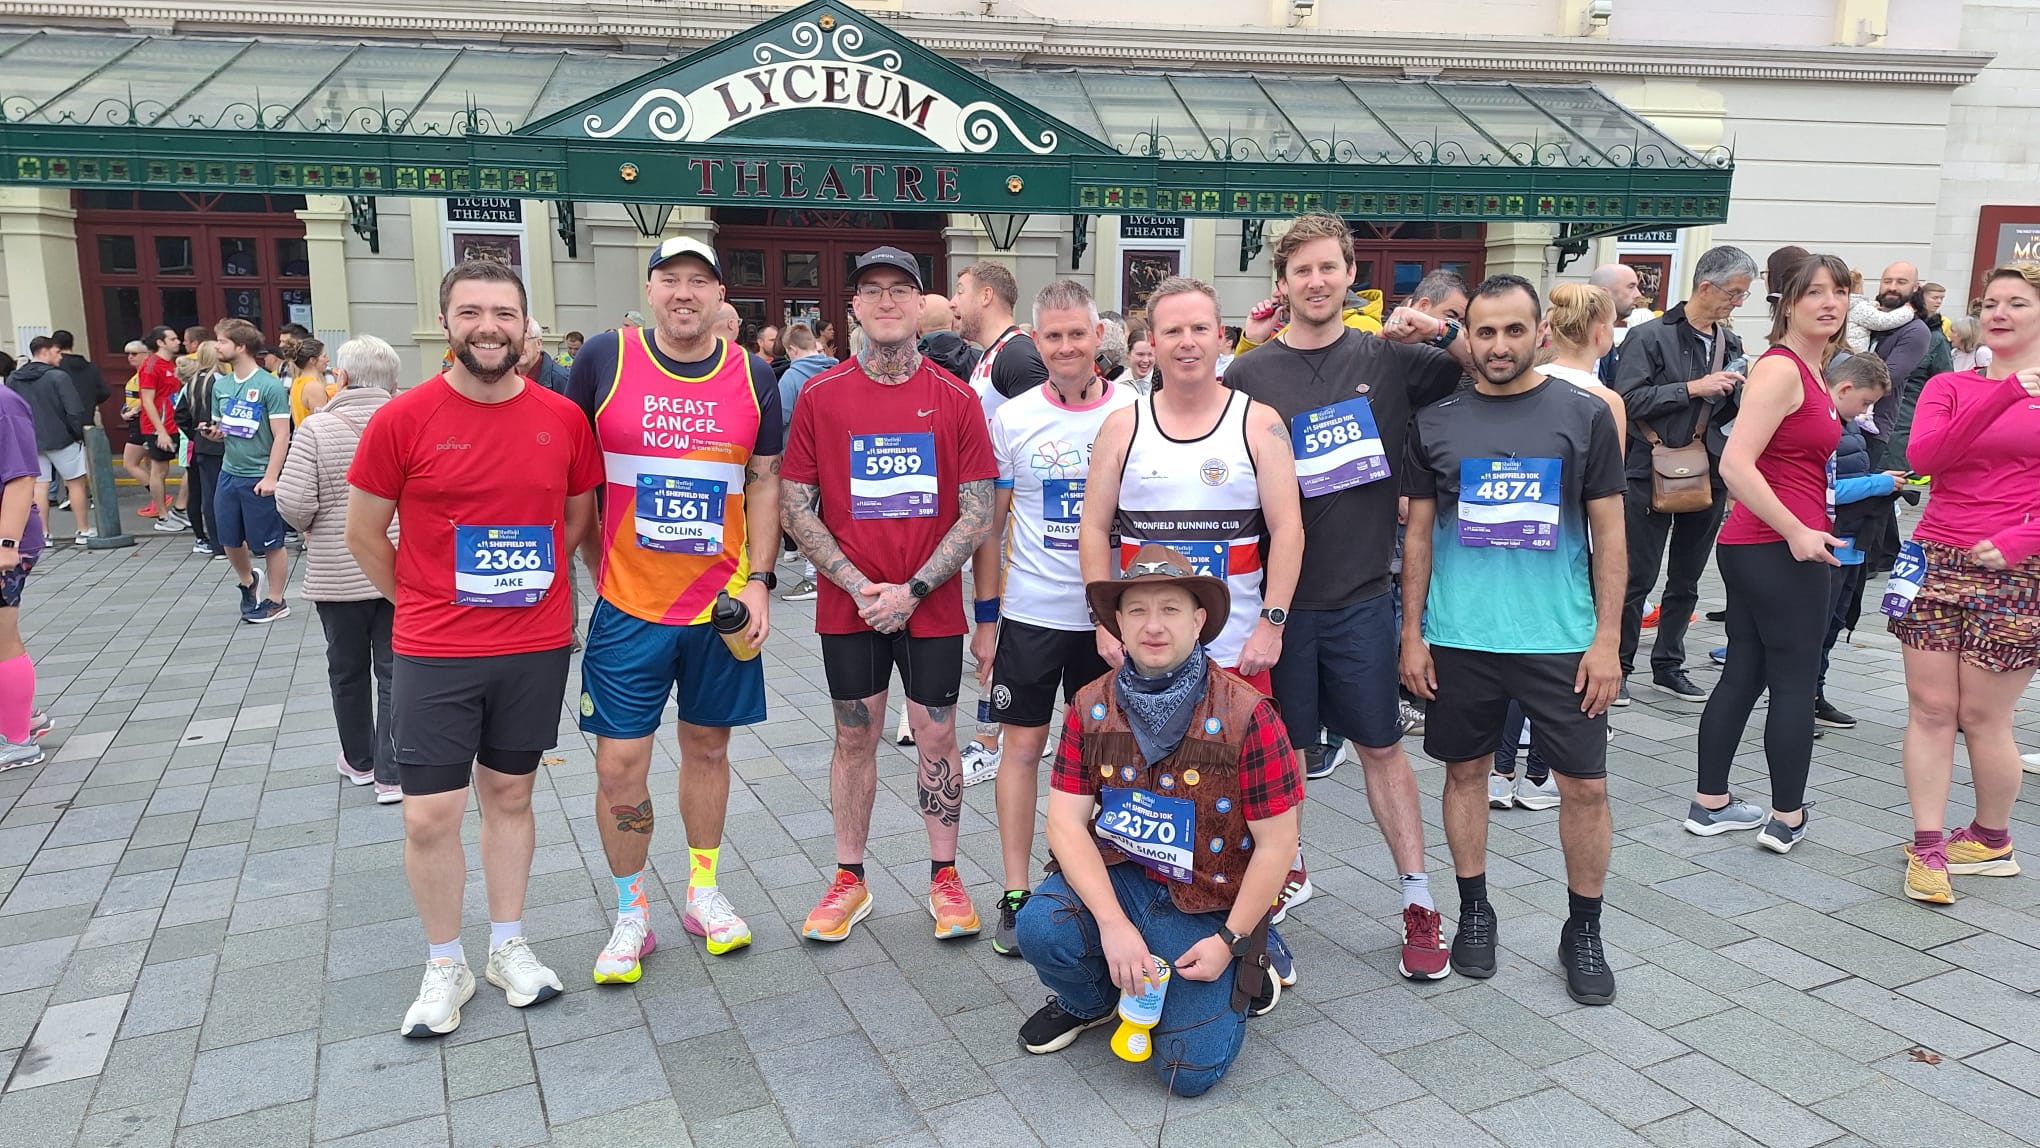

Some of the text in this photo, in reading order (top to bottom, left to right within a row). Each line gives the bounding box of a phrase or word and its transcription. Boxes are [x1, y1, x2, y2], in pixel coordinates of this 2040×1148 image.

[714, 65, 938, 131] LYCEUM
[688, 158, 962, 203] THEATRE
[457, 198, 510, 208] LYCEUM
[453, 209, 516, 220] THEATRE
[1129, 215, 1176, 225] LYCEUM
[1125, 227, 1179, 236] THEATRE
[1623, 231, 1673, 240] THEATRE
[231, 407, 254, 419] 5768
[643, 395, 718, 417] BREAST
[642, 413, 724, 433] CANCER
[1312, 413, 1355, 431] SHEFFIELD 10K
[436, 437, 472, 450] parkrun
[643, 431, 690, 450] NOW
[1305, 421, 1362, 453] 5988
[866, 455, 922, 475] 5989
[665, 490, 697, 498] SHEFFIELD
[1476, 481, 1542, 500] 4874
[654, 498, 709, 520] 1561
[658, 525, 703, 537] COLLINS
[1133, 521, 1240, 529] DRONFIELD RUNNING CLUB
[475, 550, 541, 570] 2366
[493, 578, 524, 587] JAKE
[1132, 804, 1173, 820] SHEFFIELD 10K
[1112, 811, 1176, 843] 2370
[1136, 845, 1177, 862] SIMON
